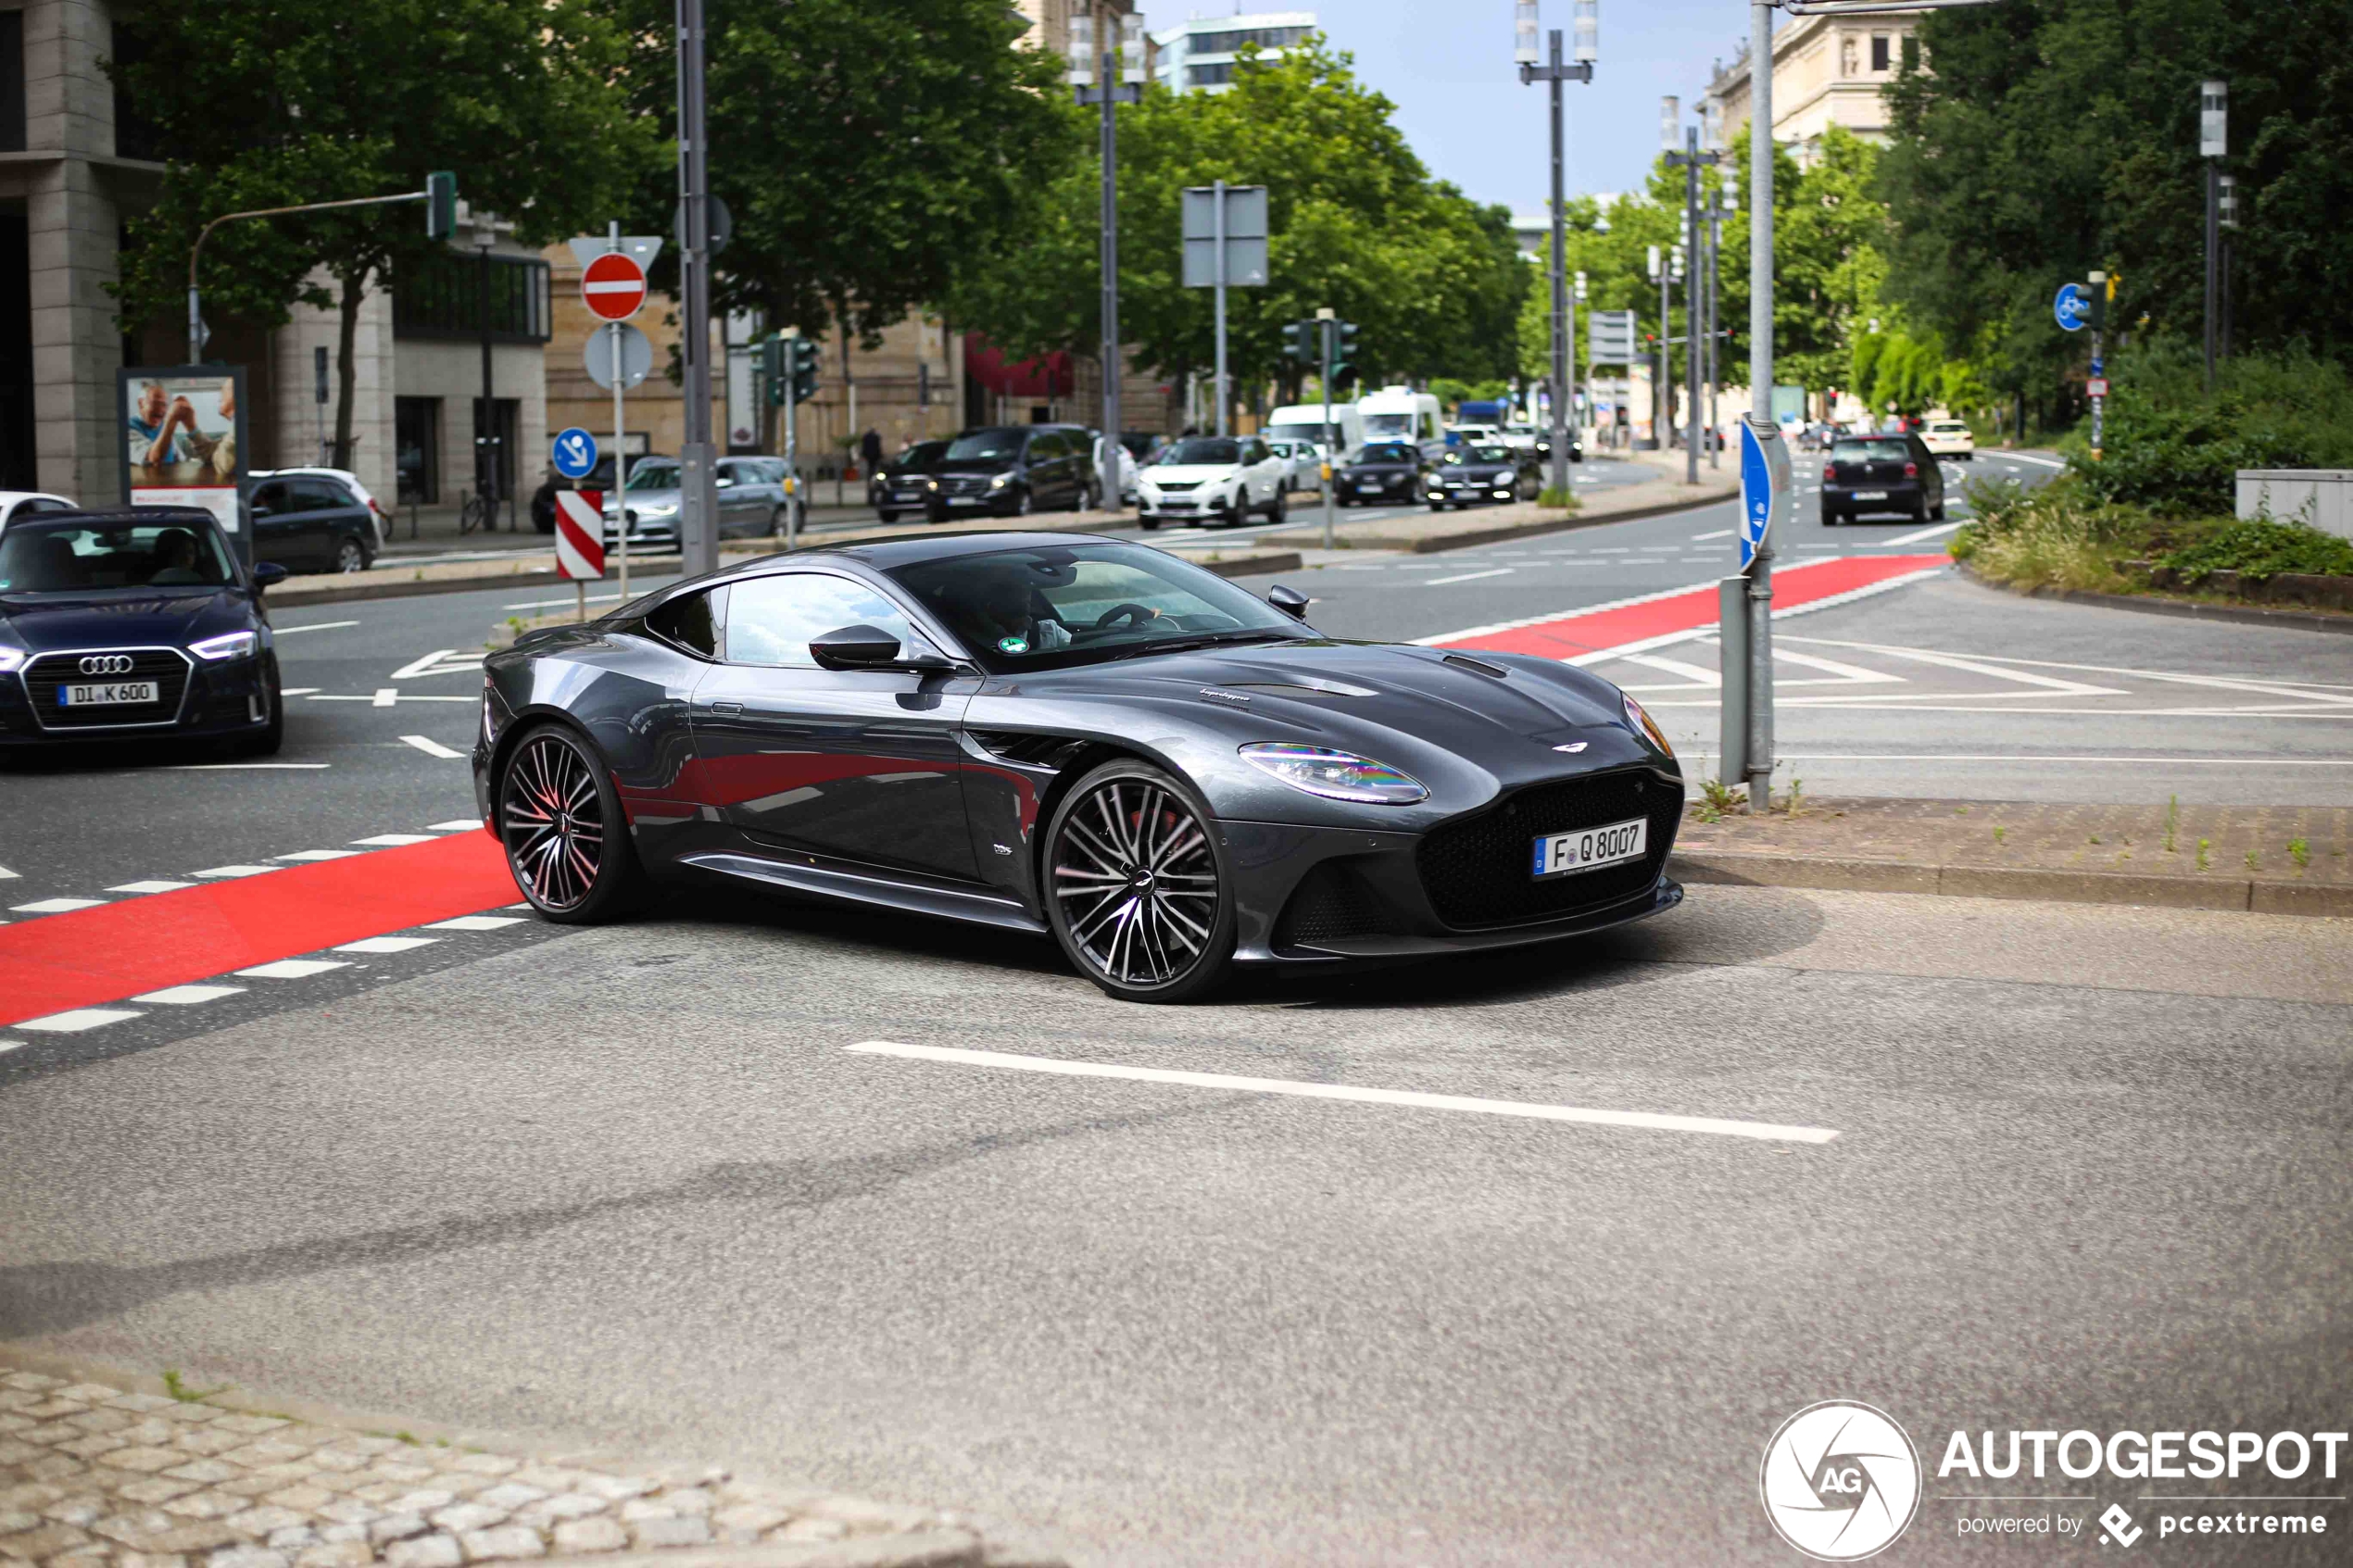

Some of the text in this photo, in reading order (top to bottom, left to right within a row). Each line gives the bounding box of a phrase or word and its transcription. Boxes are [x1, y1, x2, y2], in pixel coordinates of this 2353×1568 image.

[74, 684, 150, 703] DI K 600
[1554, 838, 1567, 868] F
[1580, 834, 1592, 861] Q
[1596, 824, 1639, 859] 8007
